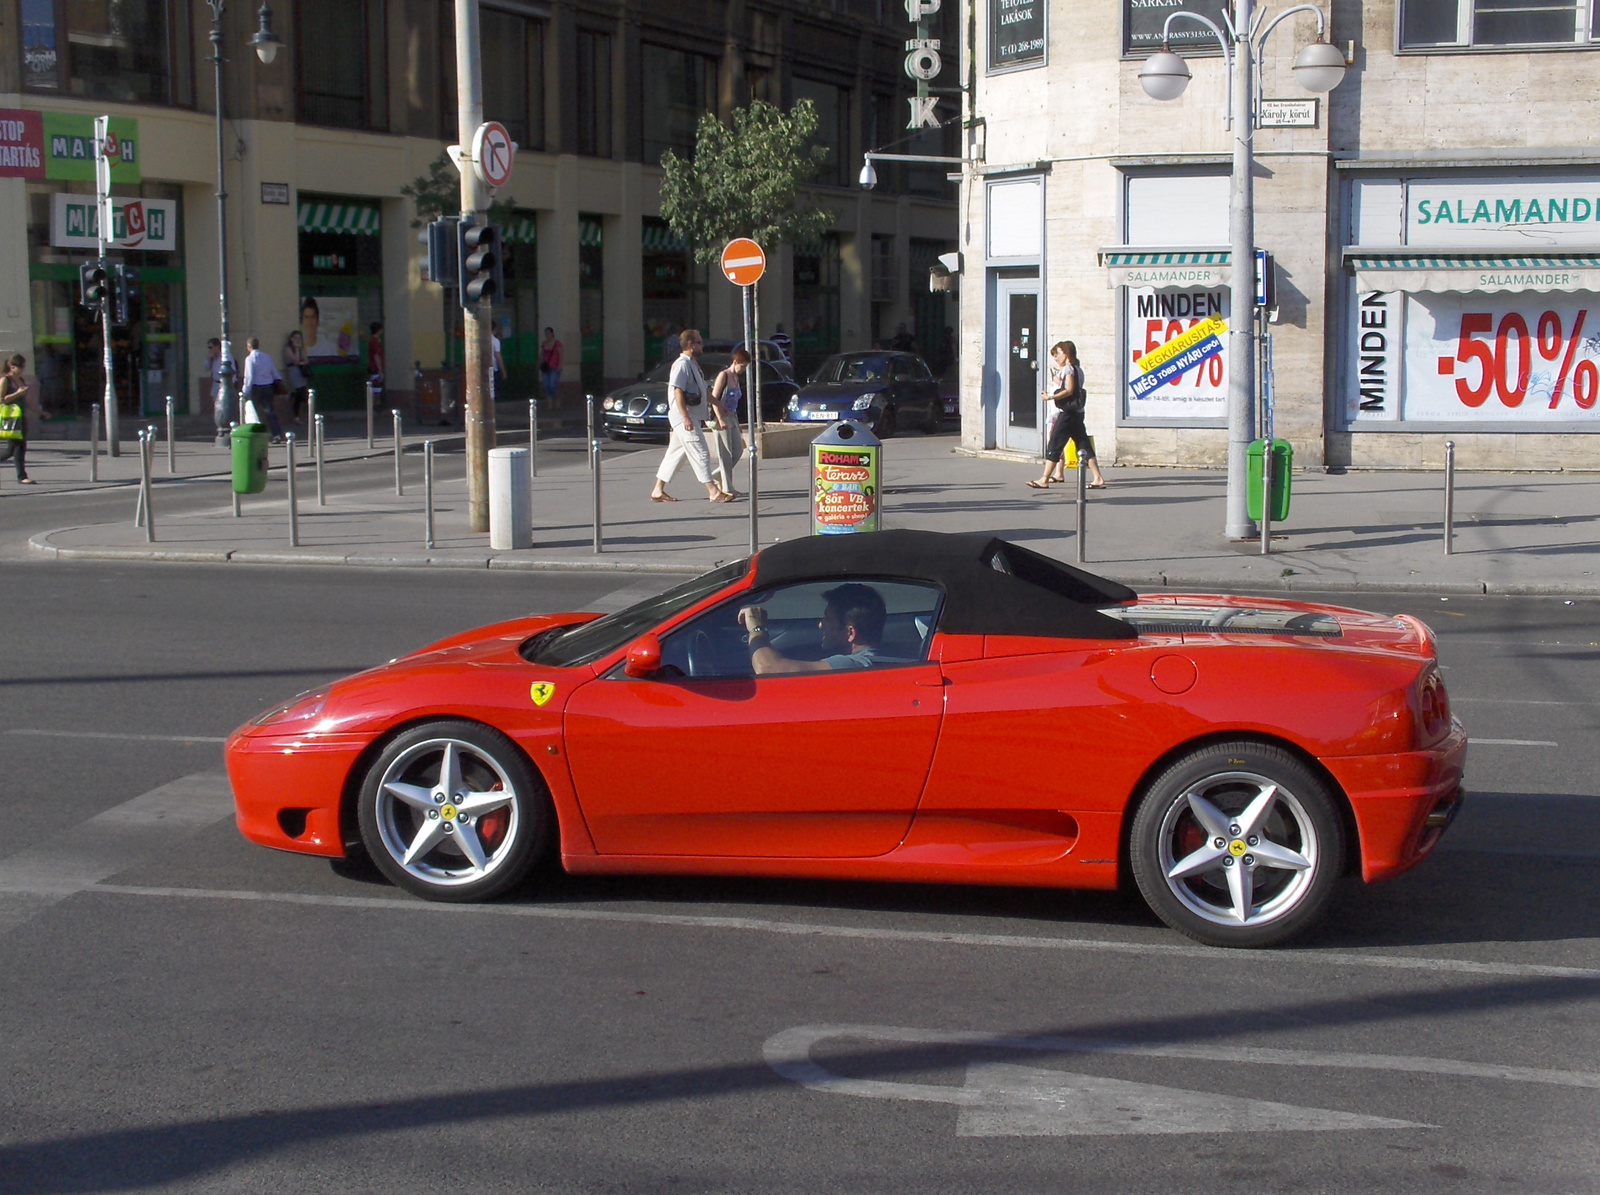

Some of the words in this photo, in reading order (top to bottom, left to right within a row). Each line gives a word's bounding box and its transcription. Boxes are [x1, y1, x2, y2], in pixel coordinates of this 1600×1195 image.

[1001, 8, 1033, 26] LAKÁSOK
[1131, 30, 1225, 41] WWW.ANRASSY3133.CO
[1263, 109, 1287, 120] Károly
[1290, 109, 1310, 118] körút
[1127, 271, 1211, 282] SALAMANDER
[1480, 273, 1569, 286] SALAMANDER
[1137, 292, 1222, 318] MINDEN
[1141, 317, 1225, 372] VÉGKIÁRUSÍTÁS!
[1360, 290, 1387, 411] MINDEN
[1438, 309, 1600, 409] -50%
[1133, 374, 1158, 396] MÉG
[1157, 363, 1177, 379] TÖBB
[1176, 347, 1203, 370] NYÁRI
[820, 452, 860, 464] ROHAM
[824, 466, 868, 480] terasz
[824, 494, 844, 504] sör
[819, 501, 870, 513] koncertek
